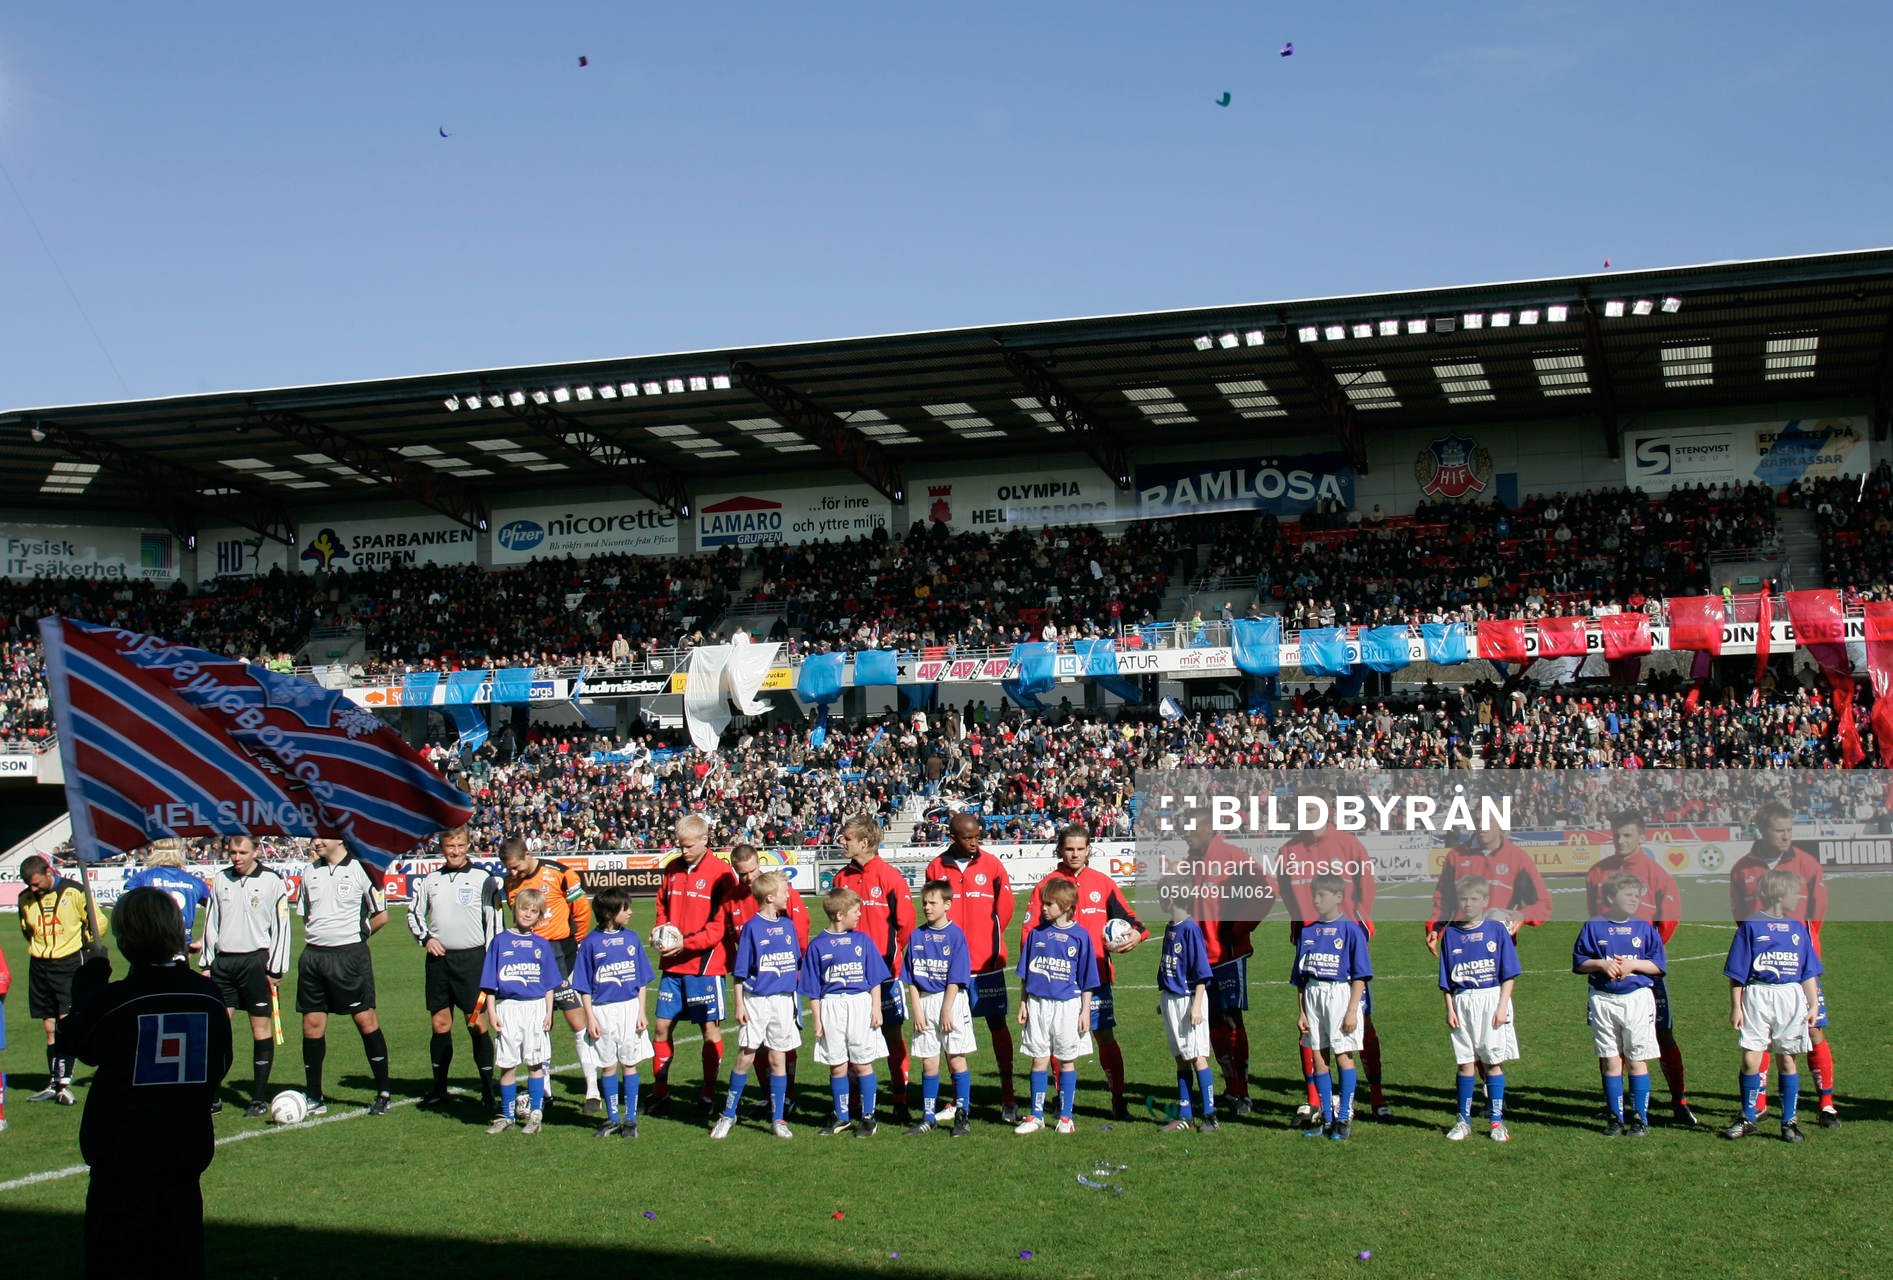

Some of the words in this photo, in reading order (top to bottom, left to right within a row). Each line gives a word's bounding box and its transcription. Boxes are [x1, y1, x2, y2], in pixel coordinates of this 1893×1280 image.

[1675, 444, 1730, 455] STENQVIST
[998, 482, 1081, 501] OLYMPIA
[1140, 459, 1346, 510] RAMLÖSA
[845, 496, 869, 509] inre
[549, 510, 676, 536] nicorette
[701, 512, 782, 534] LAMARO
[793, 518, 815, 532] och
[820, 516, 850, 533] yttre
[352, 529, 474, 550] SPARBANKEN
[736, 533, 782, 545] GRUPPEN
[8, 539, 74, 557] Fysisk
[8, 557, 127, 577] IT-säkerhet
[142, 570, 172, 578] RITTAL
[1818, 840, 1892, 865] PUMA
[584, 872, 664, 887] Wallensta
[1306, 953, 1340, 964] NDERS
[1761, 951, 1799, 961] ANDERS
[1457, 958, 1495, 972] ANDERS
